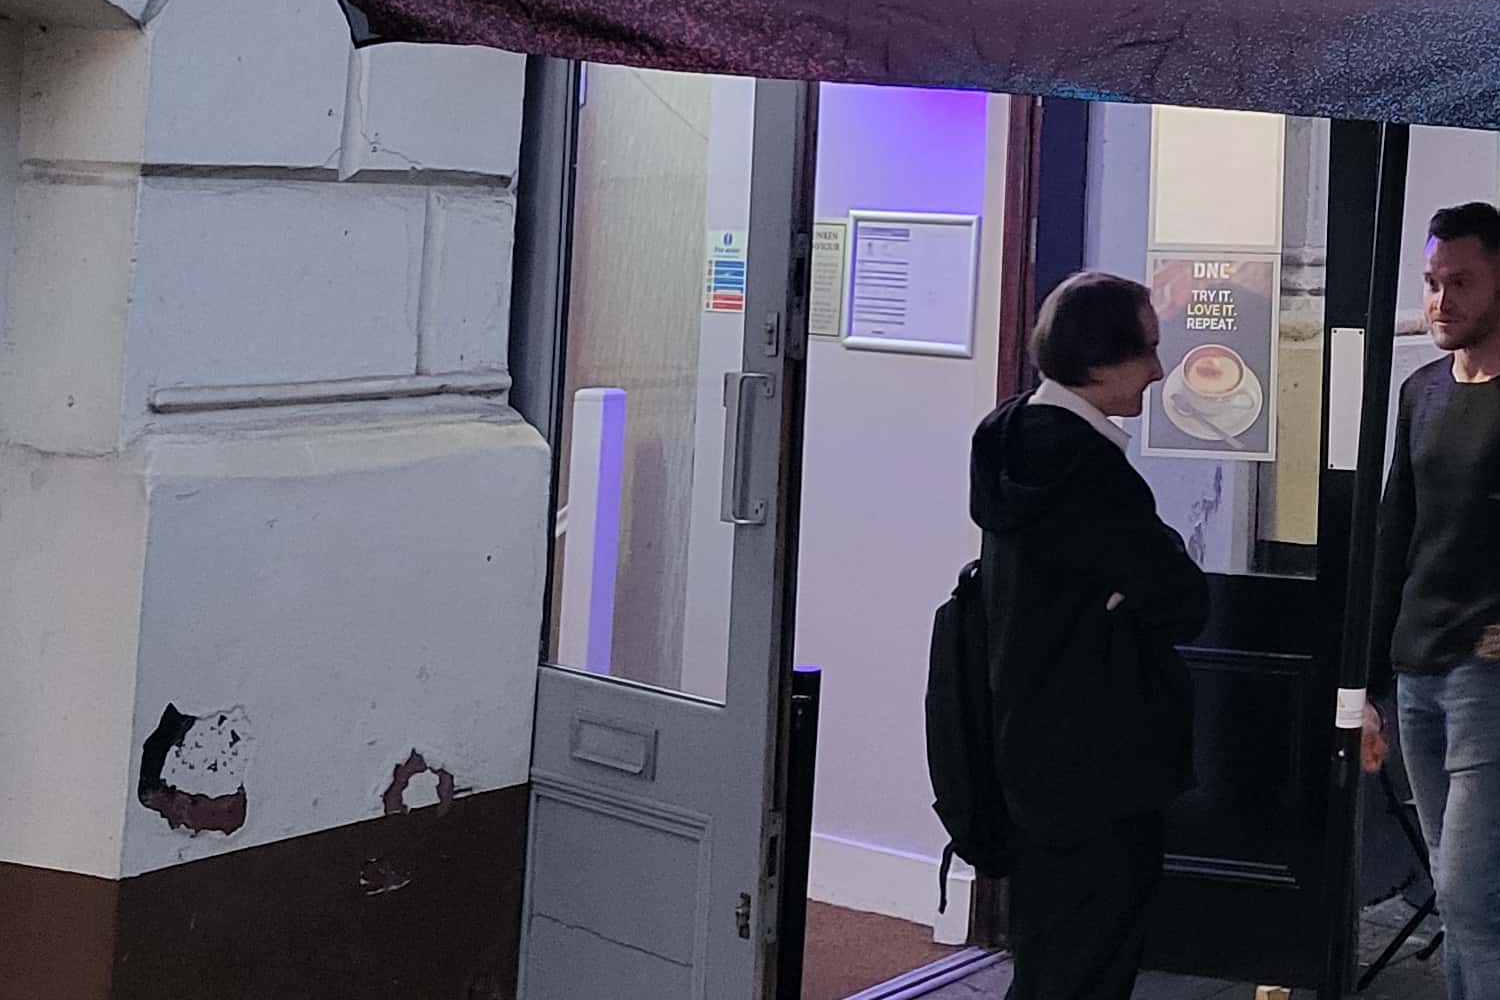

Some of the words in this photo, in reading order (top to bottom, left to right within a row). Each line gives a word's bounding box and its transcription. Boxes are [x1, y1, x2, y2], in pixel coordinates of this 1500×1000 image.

[1194, 263, 1230, 279] DNC
[1191, 289, 1216, 303] TRY
[1218, 289, 1233, 303] IT.
[1186, 303, 1221, 317] LOVE
[1222, 303, 1238, 317] IT.
[1186, 317, 1238, 331] REPEAT.
